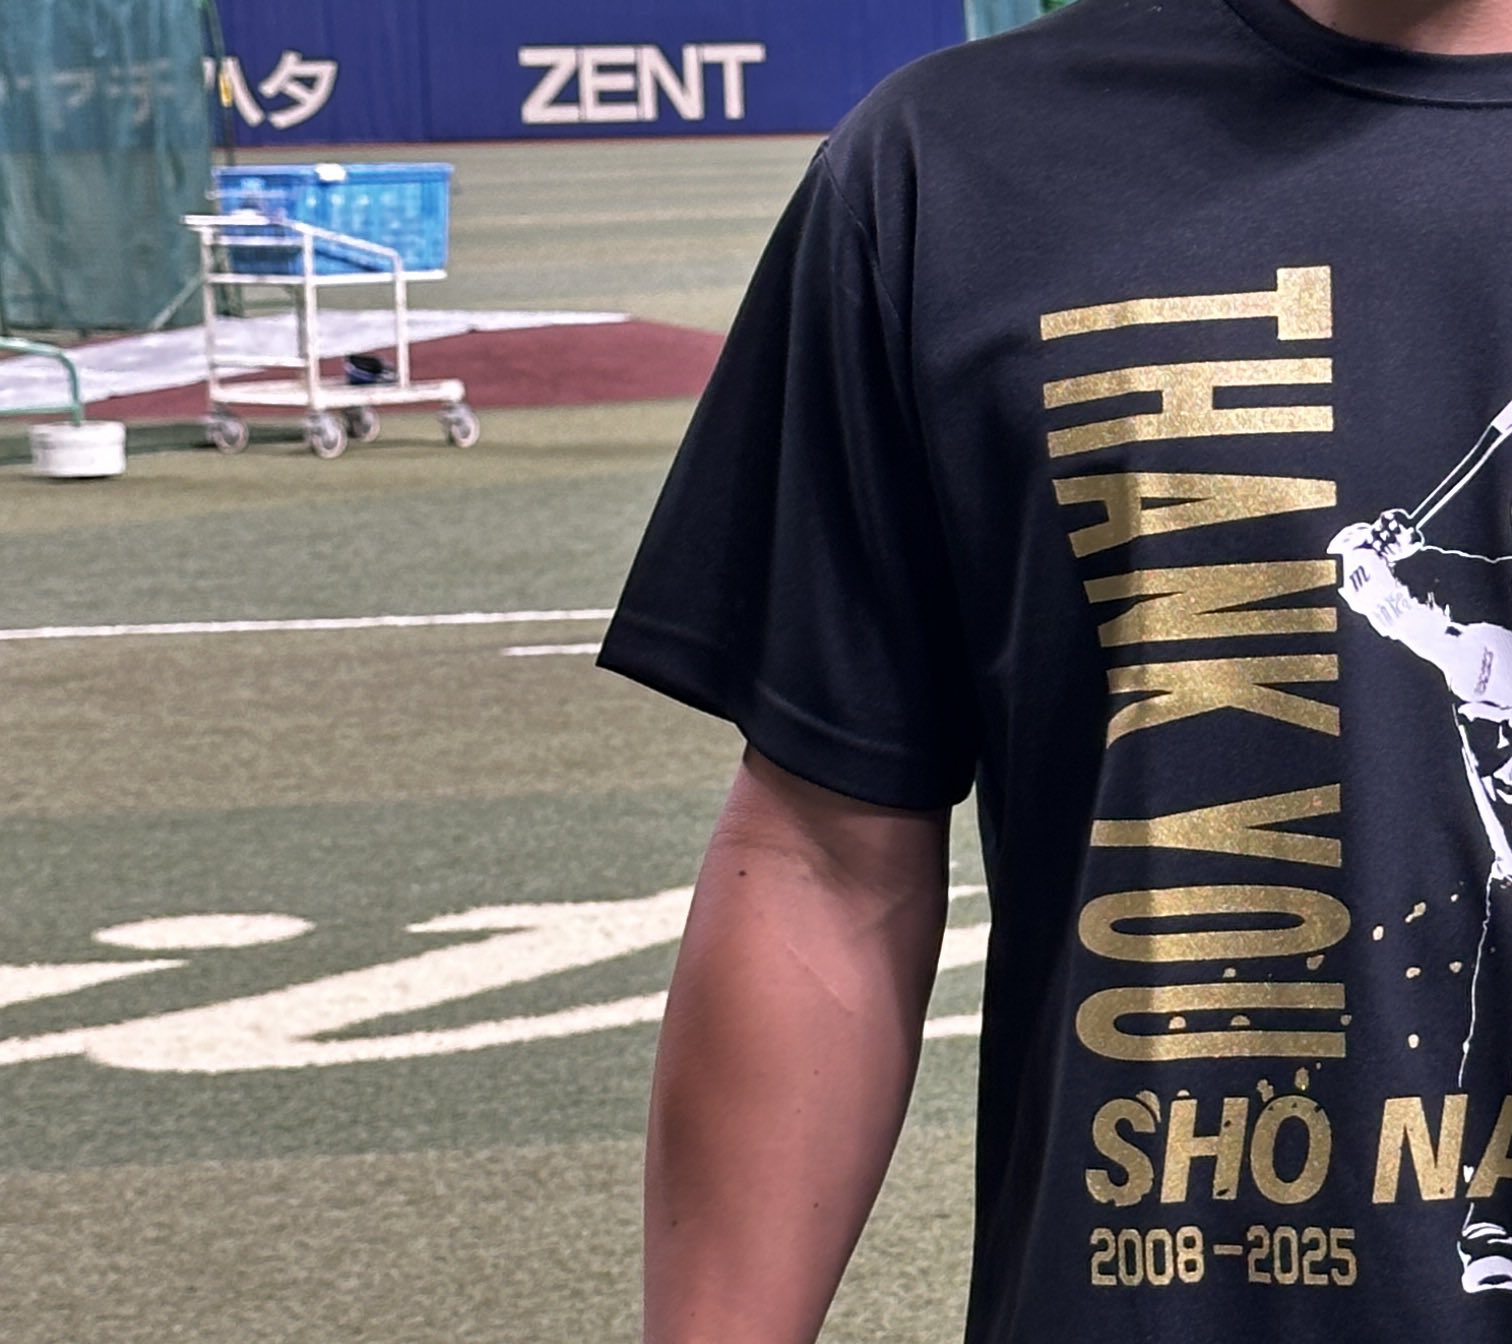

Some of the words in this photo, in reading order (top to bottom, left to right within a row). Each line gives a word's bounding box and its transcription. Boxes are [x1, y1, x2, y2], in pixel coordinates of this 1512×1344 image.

[518, 42, 767, 126] ZENT
[1040, 264, 1342, 749] THANK
[1074, 782, 1352, 1060] YOU
[1084, 1092, 1333, 1208] SHO
[1089, 1225, 1358, 1288] 2008-2025
